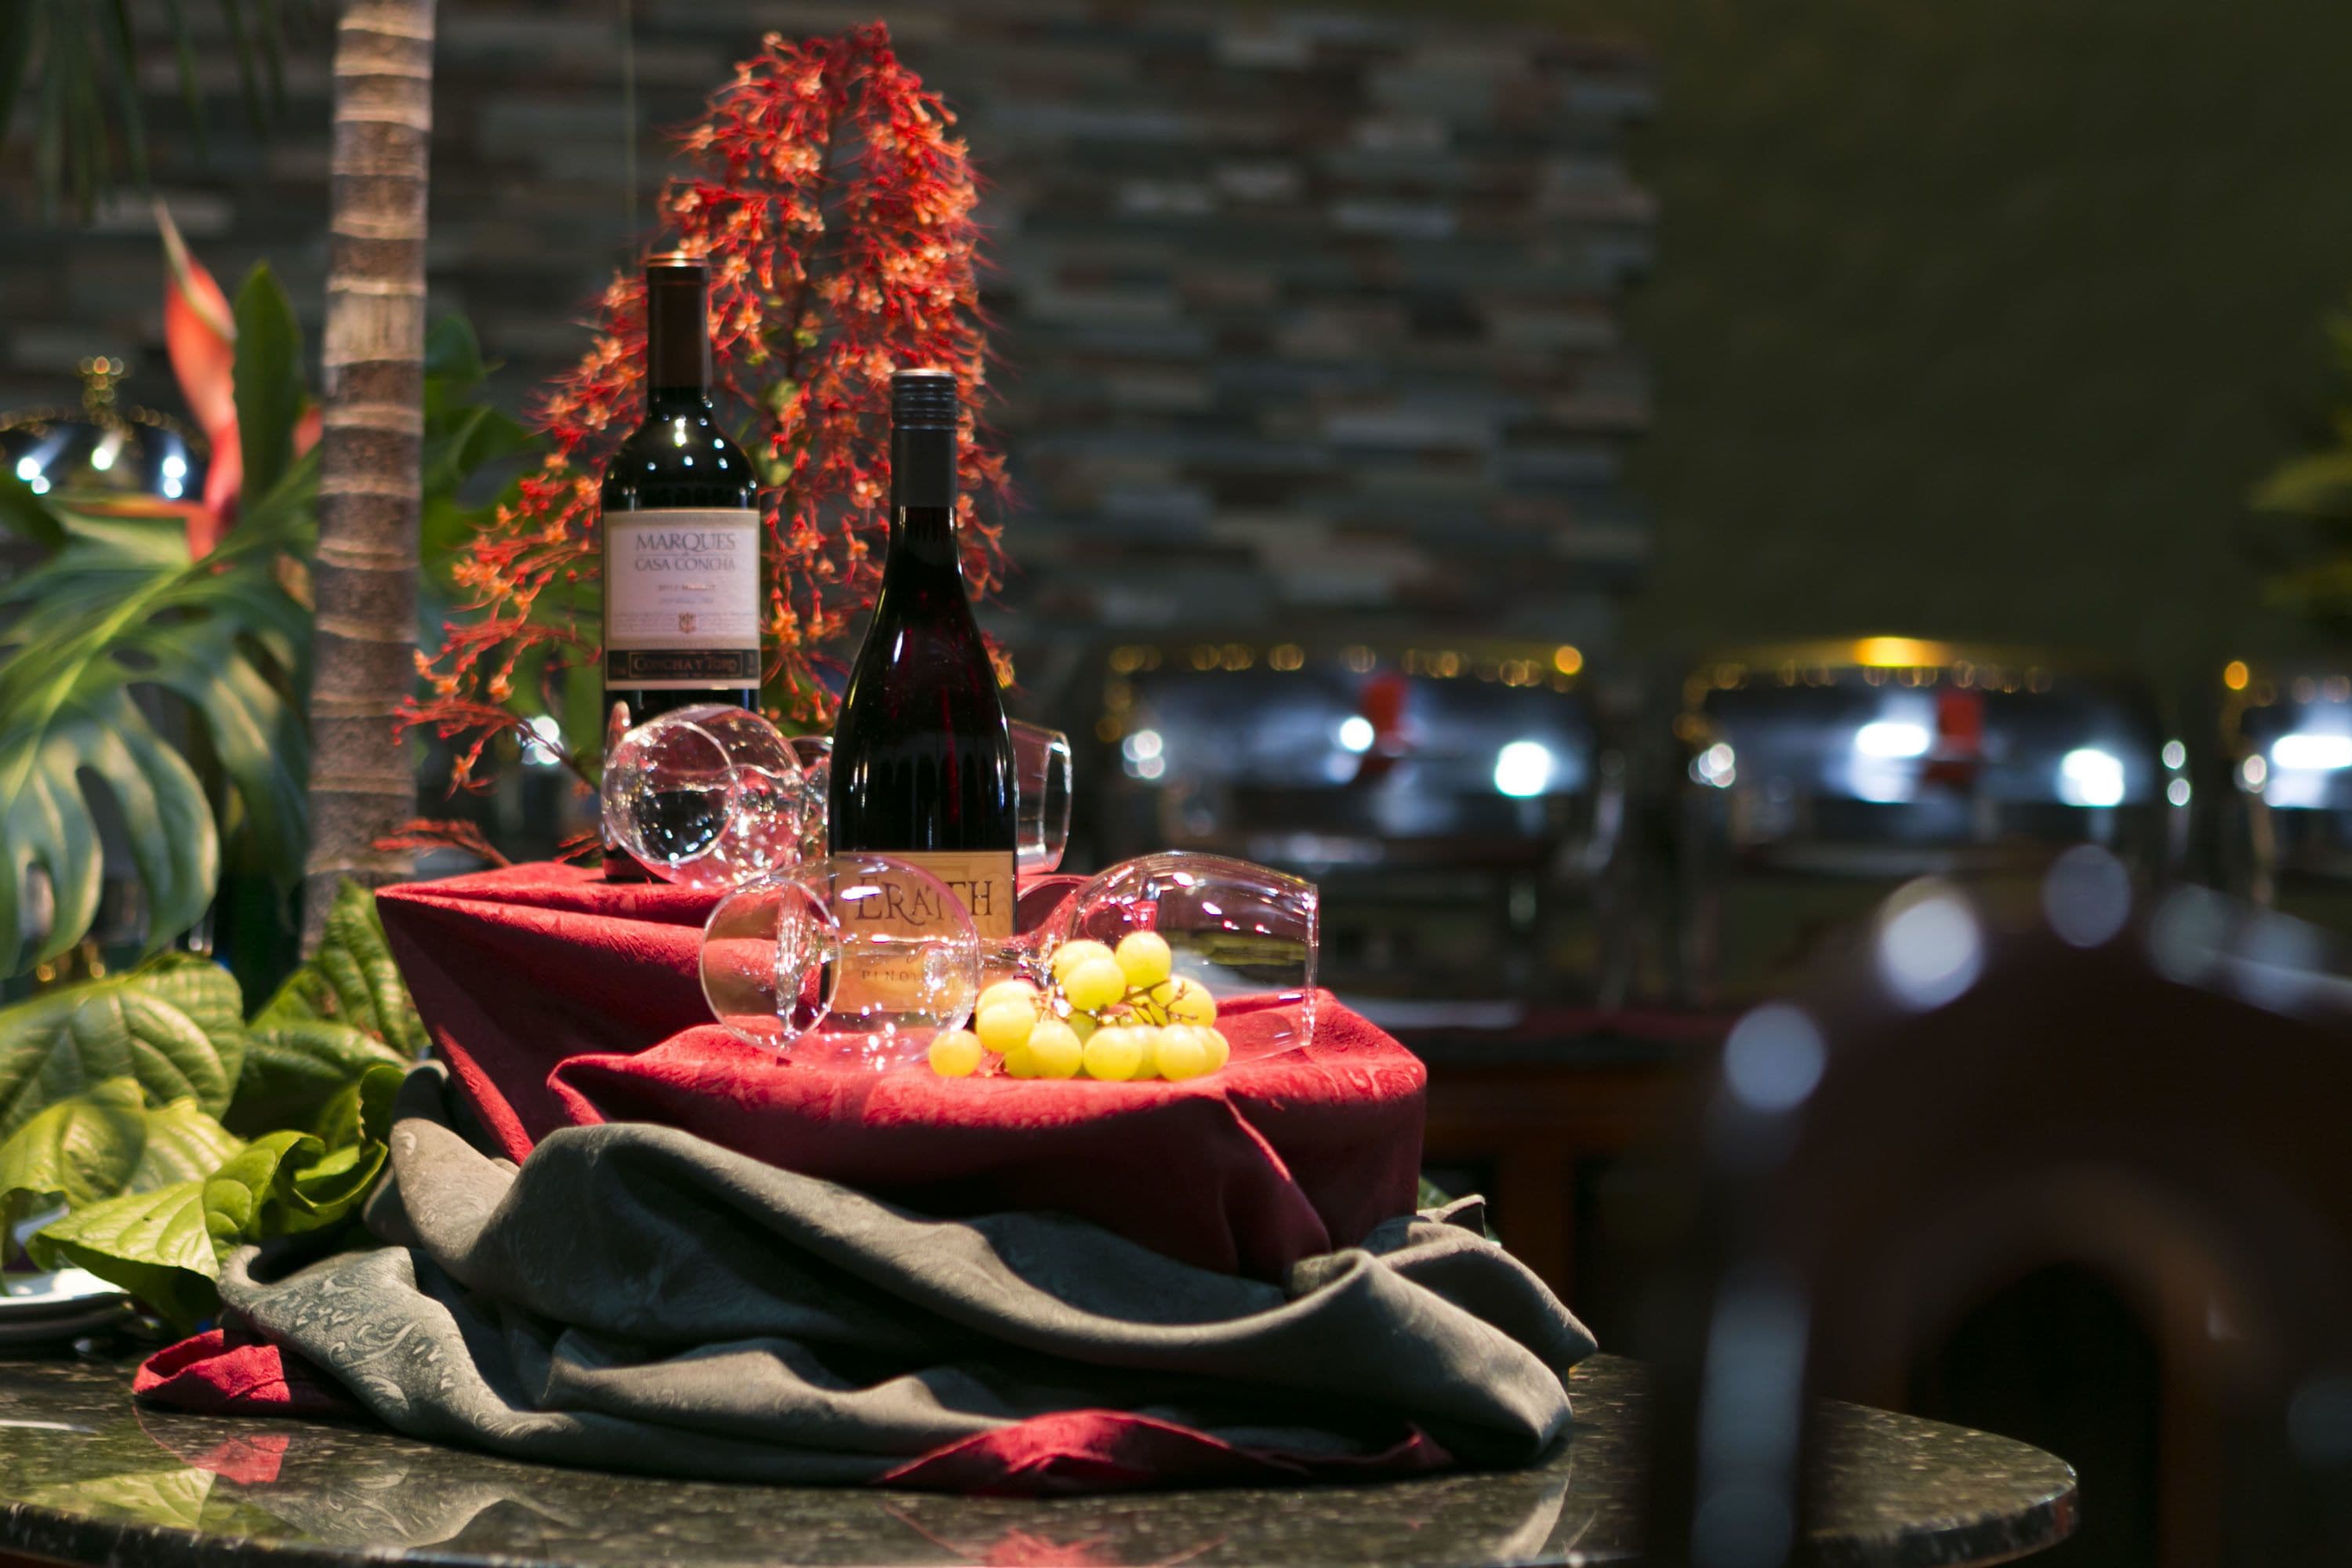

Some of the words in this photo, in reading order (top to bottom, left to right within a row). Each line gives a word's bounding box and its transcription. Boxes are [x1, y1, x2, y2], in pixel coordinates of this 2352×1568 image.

[636, 532, 735, 553] MARQUES
[634, 557, 670, 571] CASA
[674, 557, 735, 571] CONCHA
